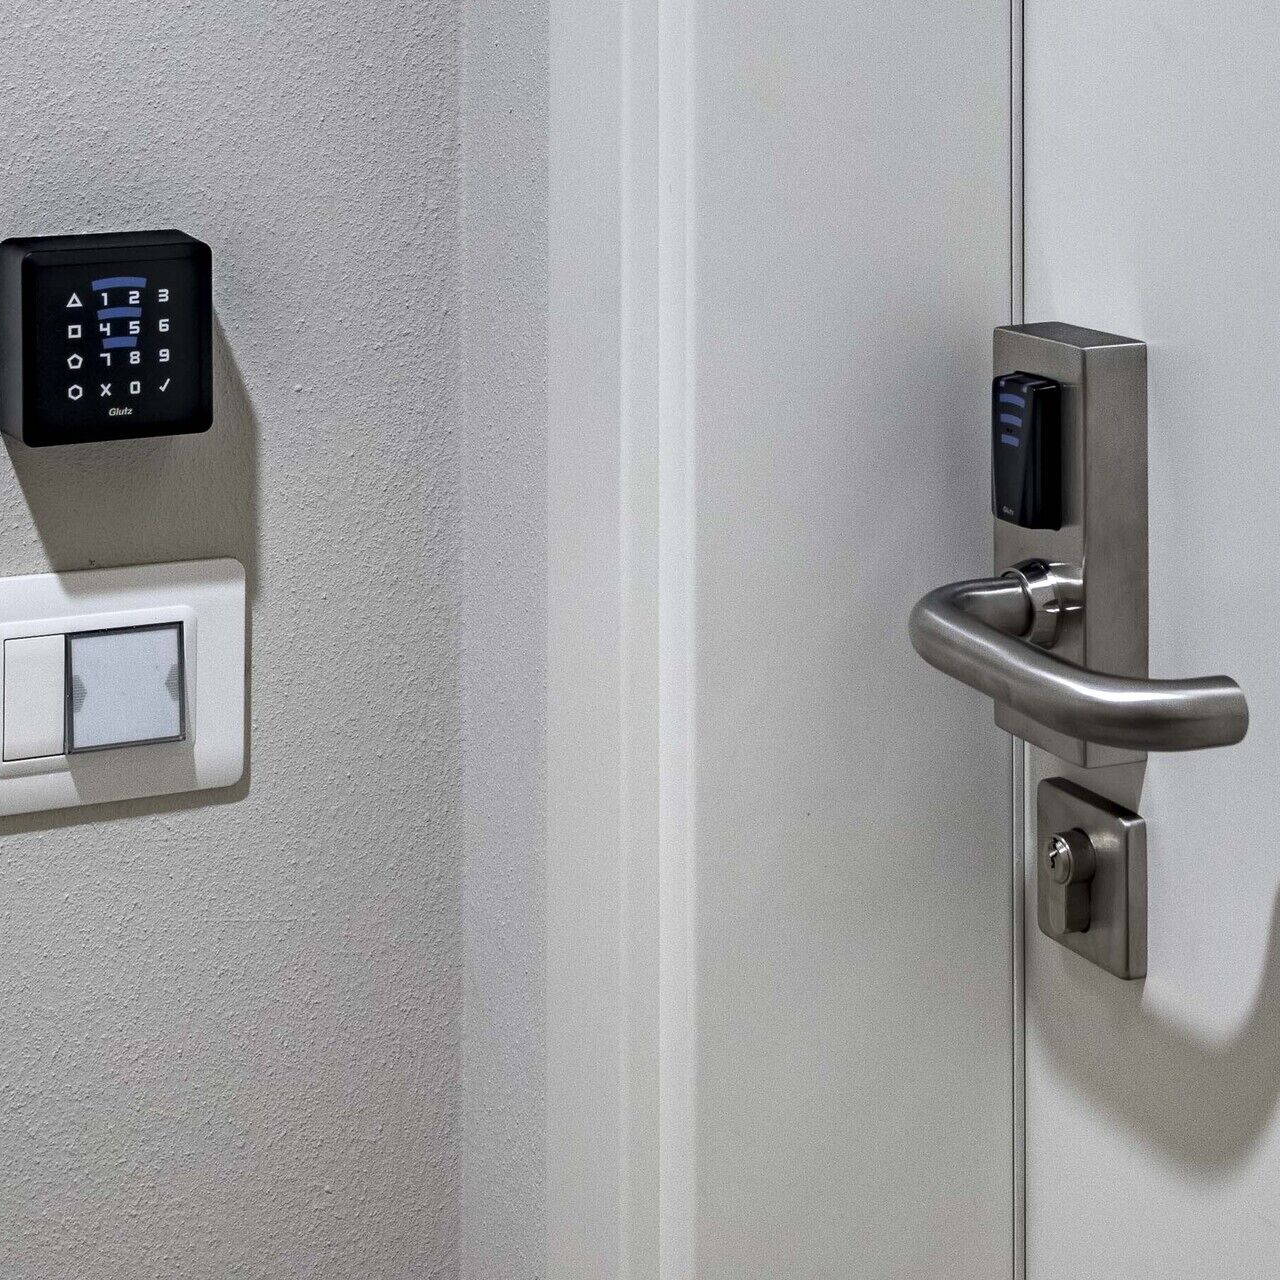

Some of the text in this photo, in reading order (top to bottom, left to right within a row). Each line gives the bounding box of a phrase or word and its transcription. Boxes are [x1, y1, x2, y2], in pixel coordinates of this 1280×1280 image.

[101, 288, 169, 306] 1 2 3
[99, 318, 170, 336] 4 5 6
[100, 348, 170, 366] 7 8 9
[129, 381, 140, 395] 0
[108, 406, 133, 417] Glutz
